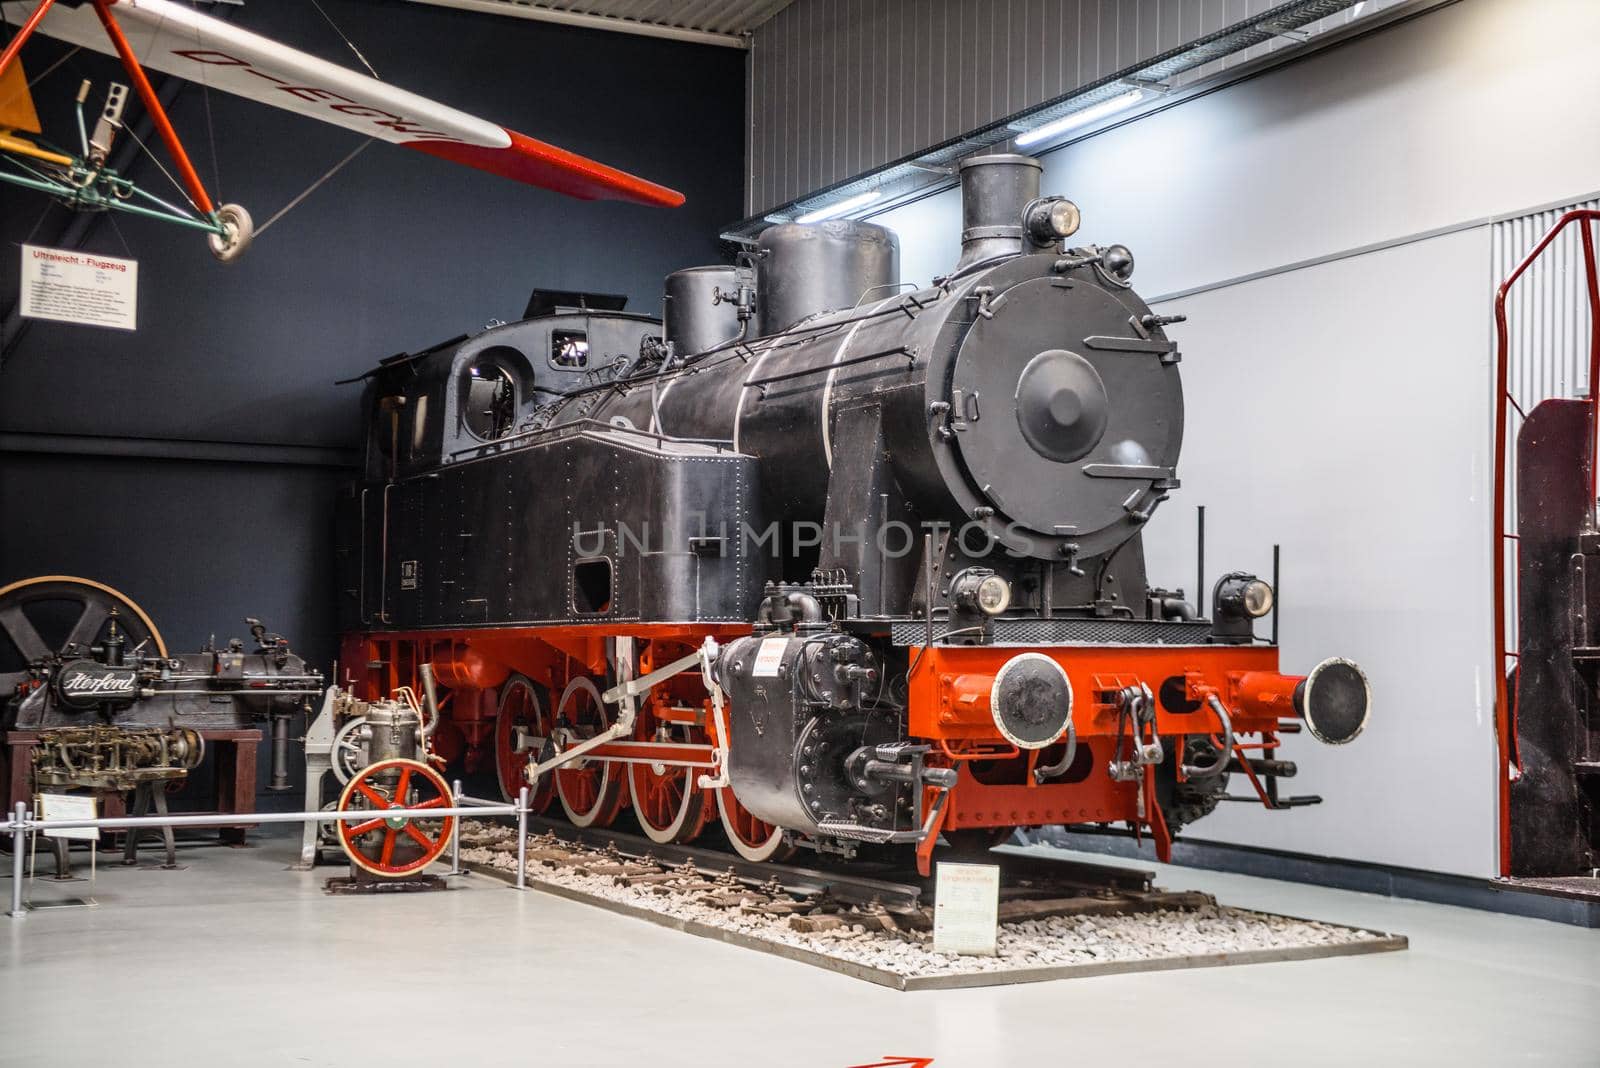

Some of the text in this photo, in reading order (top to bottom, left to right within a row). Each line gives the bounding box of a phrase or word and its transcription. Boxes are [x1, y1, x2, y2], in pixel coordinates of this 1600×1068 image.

[33, 250, 79, 264] Ultraleicht
[86, 258, 127, 272] Flugzeug
[64, 672, 136, 693] Herford
